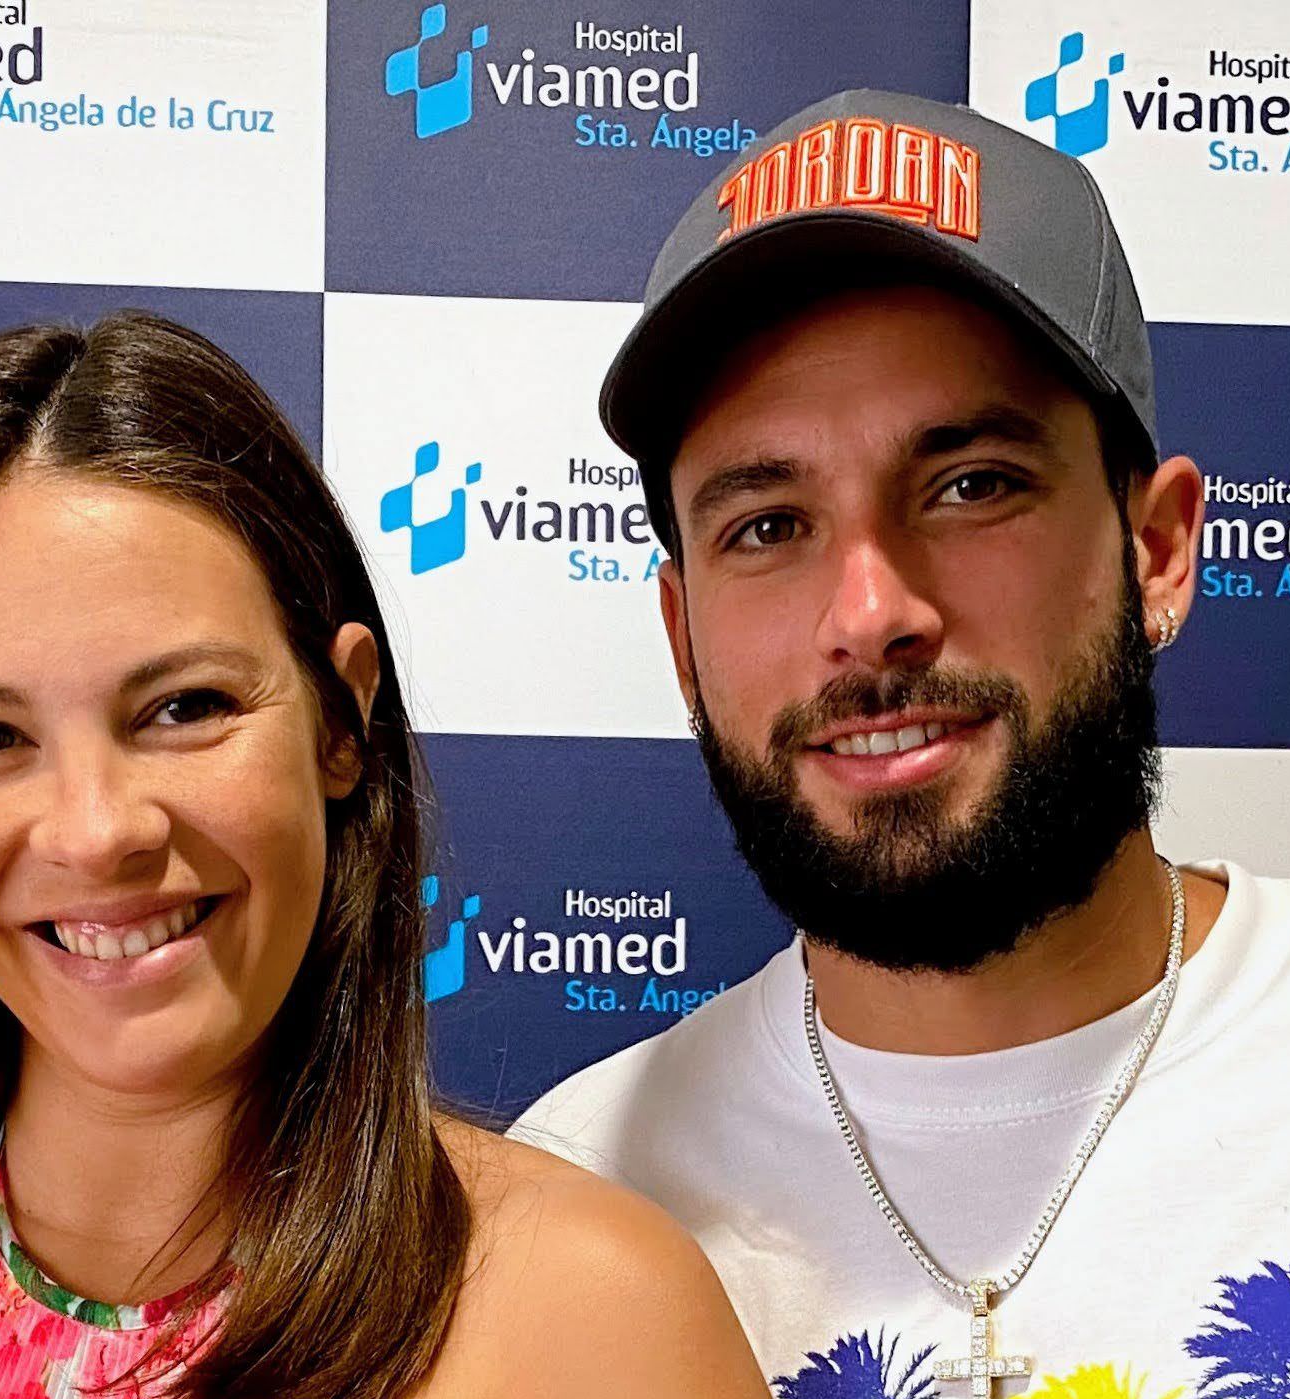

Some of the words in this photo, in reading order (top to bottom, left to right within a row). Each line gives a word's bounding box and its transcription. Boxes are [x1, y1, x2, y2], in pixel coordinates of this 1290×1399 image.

[573, 21, 683, 57] Hospital
[486, 48, 698, 113] viamed
[116, 96, 156, 127] de
[168, 98, 195, 129] la
[206, 99, 273, 134] Cruz
[574, 113, 638, 149] Sta.
[1207, 139, 1269, 173] Sta.
[717, 116, 981, 242] JORDAN
[568, 549, 630, 582] Sta.
[1202, 565, 1263, 597] Sta.
[565, 889, 671, 924] Hospital
[477, 917, 686, 976] viamed
[564, 979, 627, 1012] Sta.
